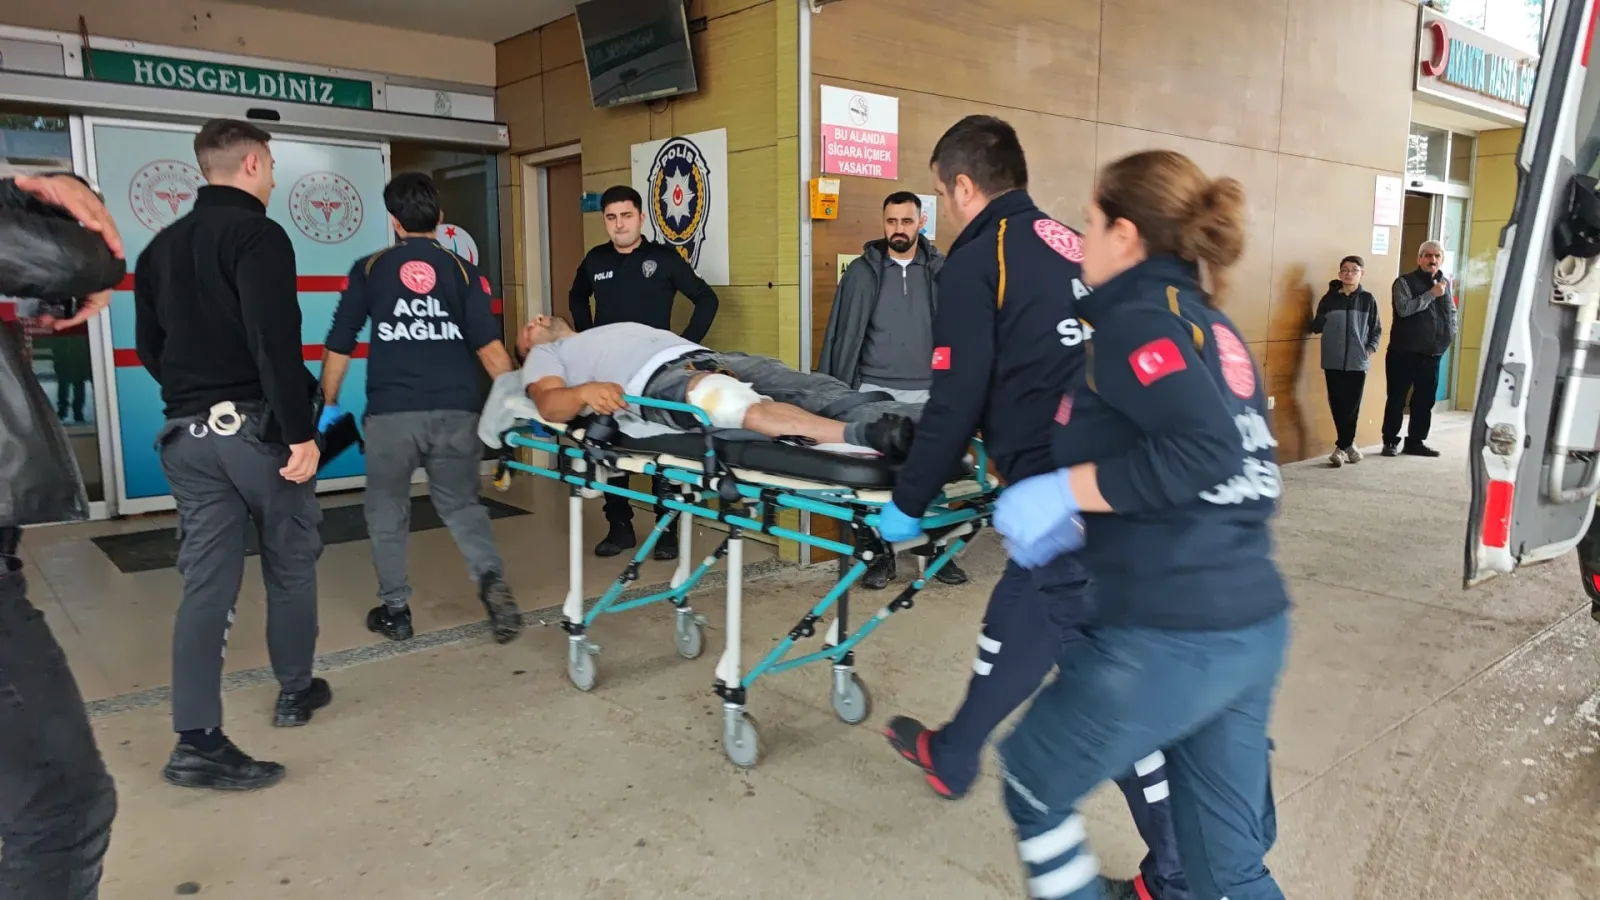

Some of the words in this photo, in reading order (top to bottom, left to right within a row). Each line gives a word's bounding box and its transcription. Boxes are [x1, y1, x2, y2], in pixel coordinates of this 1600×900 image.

[1447, 38, 1485, 91] AYAKTA
[1488, 53, 1517, 102] HASTA
[834, 127, 848, 141] BU
[849, 130, 886, 146] ALANDA
[827, 141, 863, 159] SİGARA
[864, 146, 892, 162] İÇMEK
[838, 160, 882, 176] YASAKTIR
[393, 295, 449, 317] ACİL
